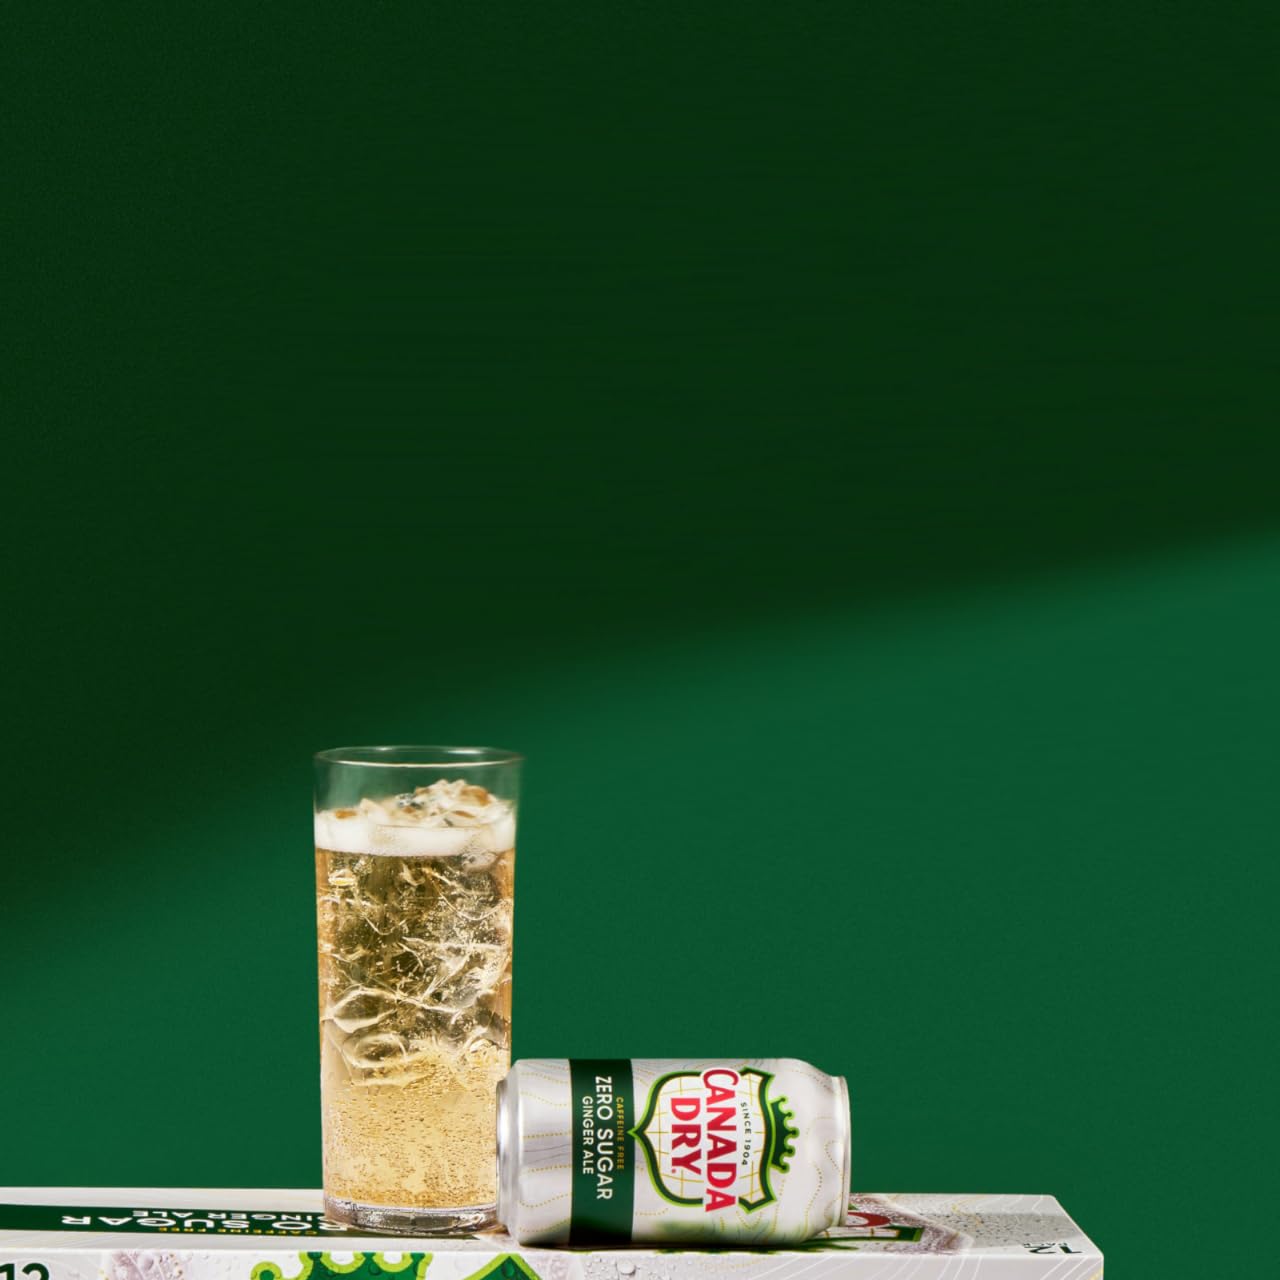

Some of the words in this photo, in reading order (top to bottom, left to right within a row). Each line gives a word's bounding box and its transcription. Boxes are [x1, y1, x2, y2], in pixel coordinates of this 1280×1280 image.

[595, 1076, 613, 1121] ZERO
[582, 1095, 594, 1146] GINGER
[616, 1096, 625, 1142] CAFFEINE
[671, 1097, 702, 1175] DRY
[740, 1102, 752, 1135] SINCE
[616, 1146, 625, 1170] FREE
[703, 1069, 739, 1212] CANADA
[741, 1138, 752, 1166] 1904
[582, 1150, 594, 1175] ALE
[596, 1128, 614, 1200] SUGAR
[61, 1215, 250, 1229] SUGAR
[132, 1210, 194, 1219] ALE
